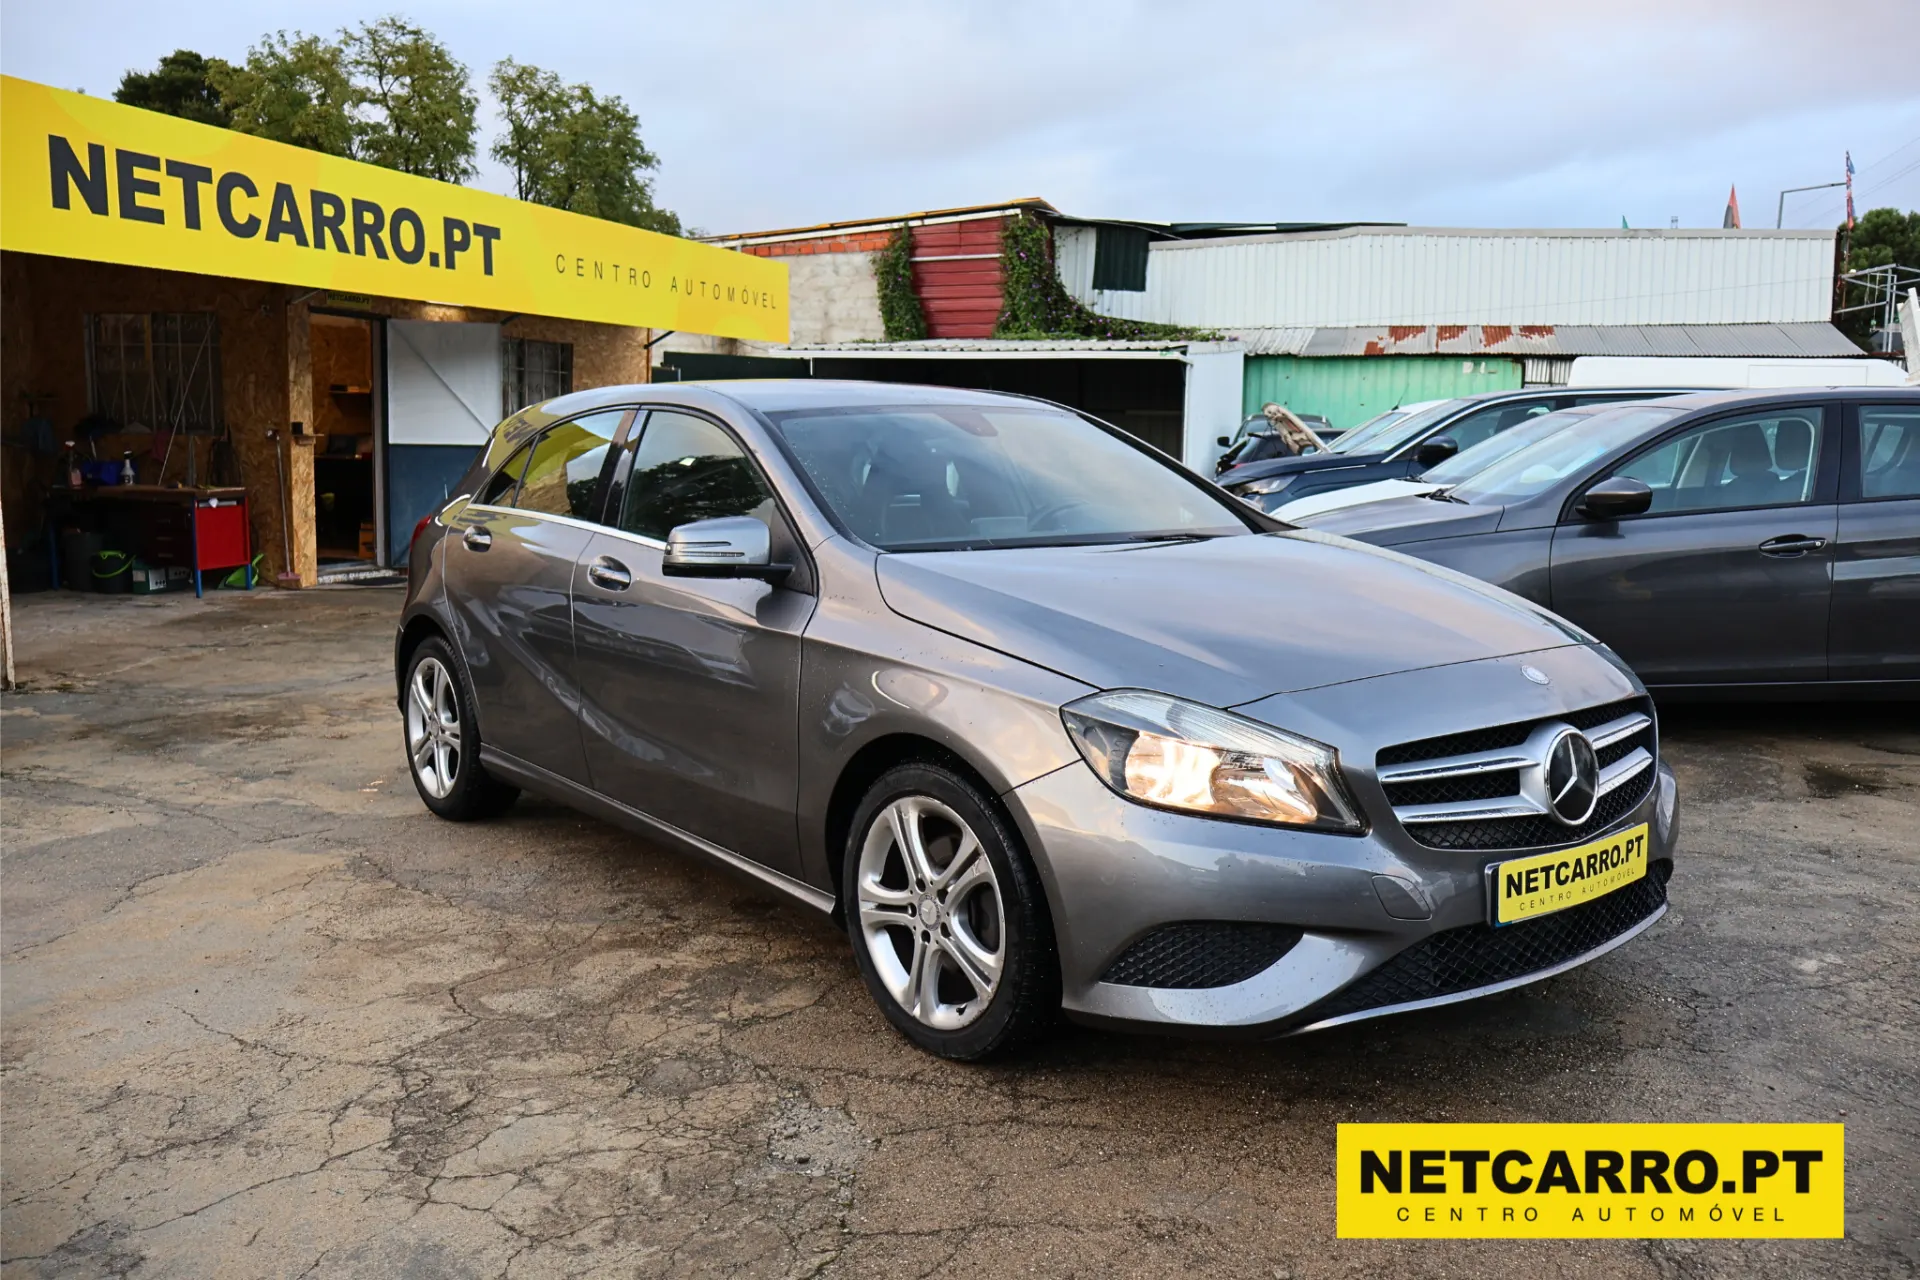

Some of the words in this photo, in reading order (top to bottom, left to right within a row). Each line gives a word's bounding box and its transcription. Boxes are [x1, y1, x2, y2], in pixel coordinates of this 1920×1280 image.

[48, 134, 501, 276] NETCARRO.PT
[556, 254, 651, 288] CENTRO
[670, 276, 776, 309] AUTOMÓVEL
[1506, 834, 1644, 898] NETCARRO.PT
[1519, 890, 1572, 911] CENTRO
[1581, 866, 1635, 894] AUTOMÓVEL
